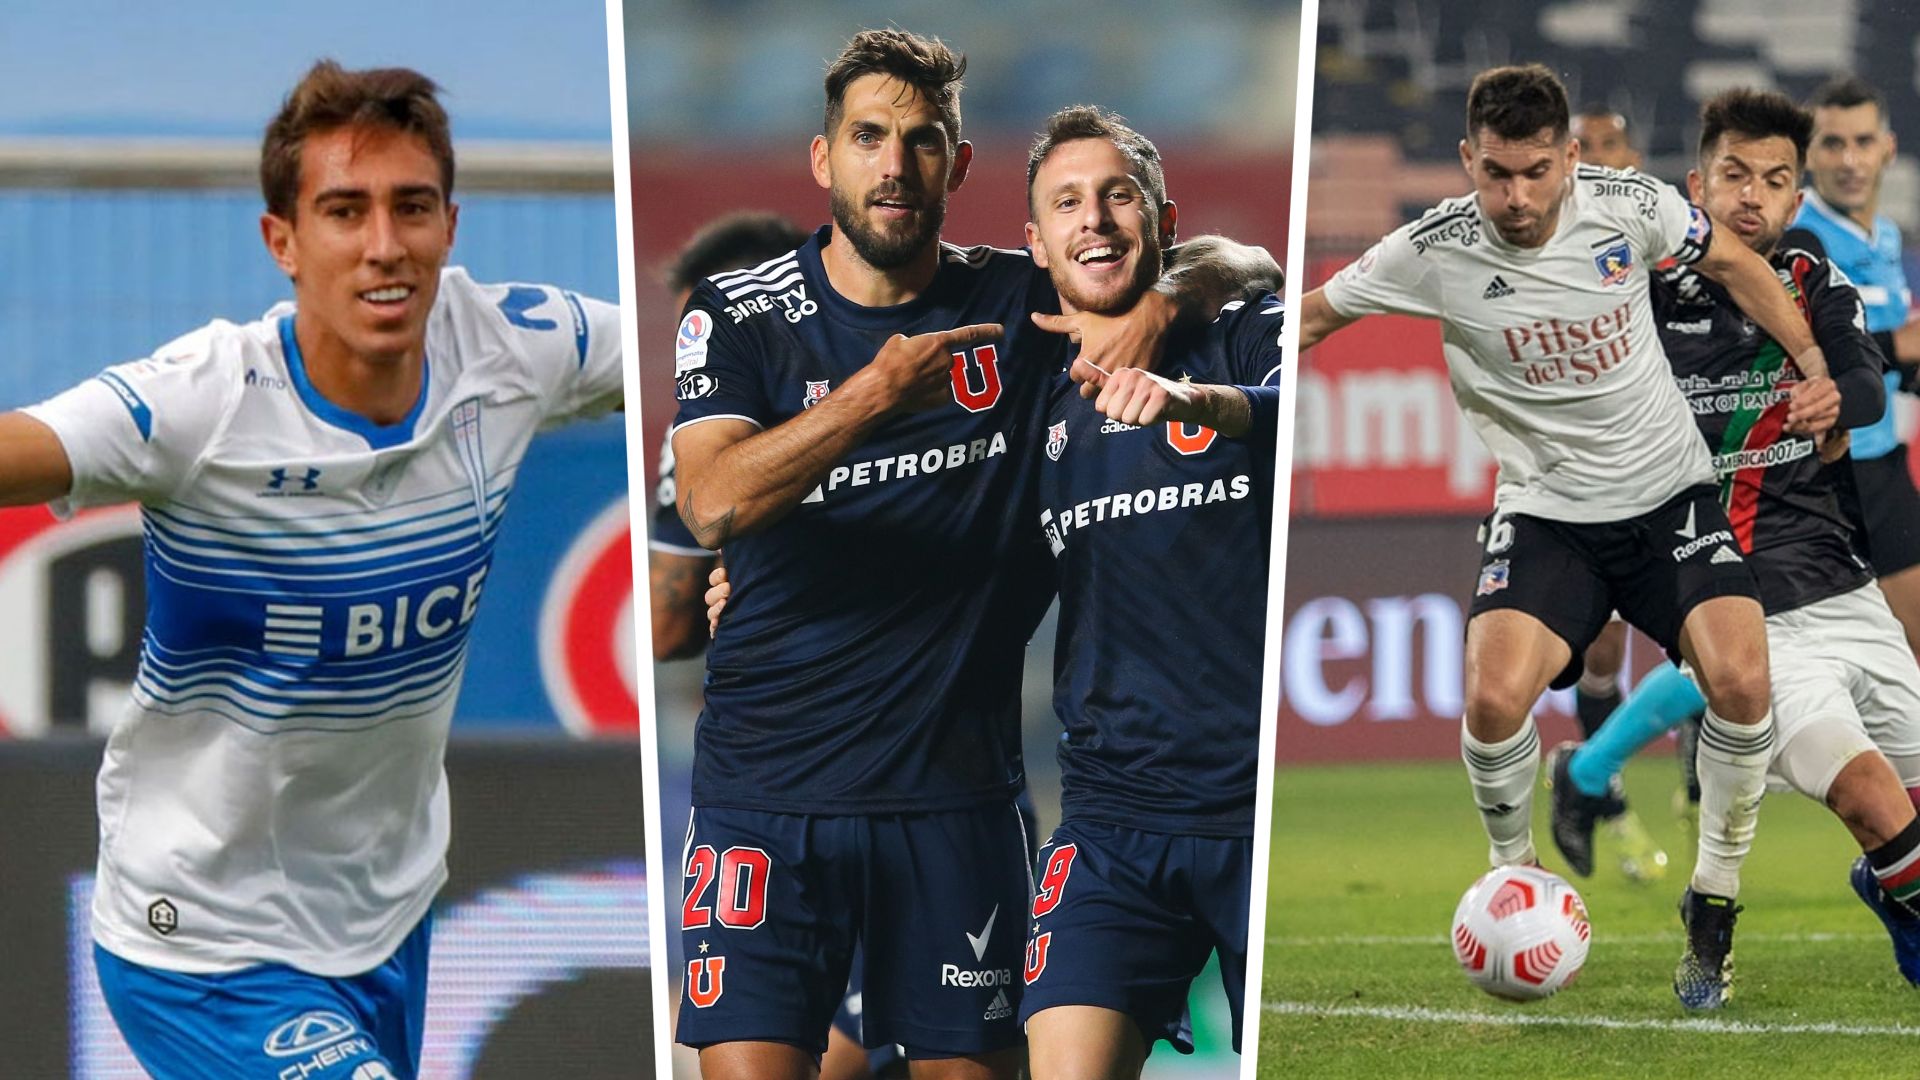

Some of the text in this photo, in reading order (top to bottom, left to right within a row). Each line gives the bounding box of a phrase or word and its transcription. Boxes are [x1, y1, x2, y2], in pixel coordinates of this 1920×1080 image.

[1460, 230, 1480, 247] GO
[784, 299, 819, 324] GO
[1503, 302, 1632, 363] Pilsen
[1524, 332, 1633, 386] del Sur
[828, 431, 1008, 491] PETROBRA
[1059, 474, 1251, 537] PETROBRAS
[1672, 530, 1733, 562] Rexona
[344, 564, 488, 658] BICE
[682, 844, 772, 930] 20
[1032, 843, 1078, 919] 9
[688, 956, 726, 1008] U
[941, 963, 1011, 988] Rexona
[983, 1008, 1014, 1020] adidas
